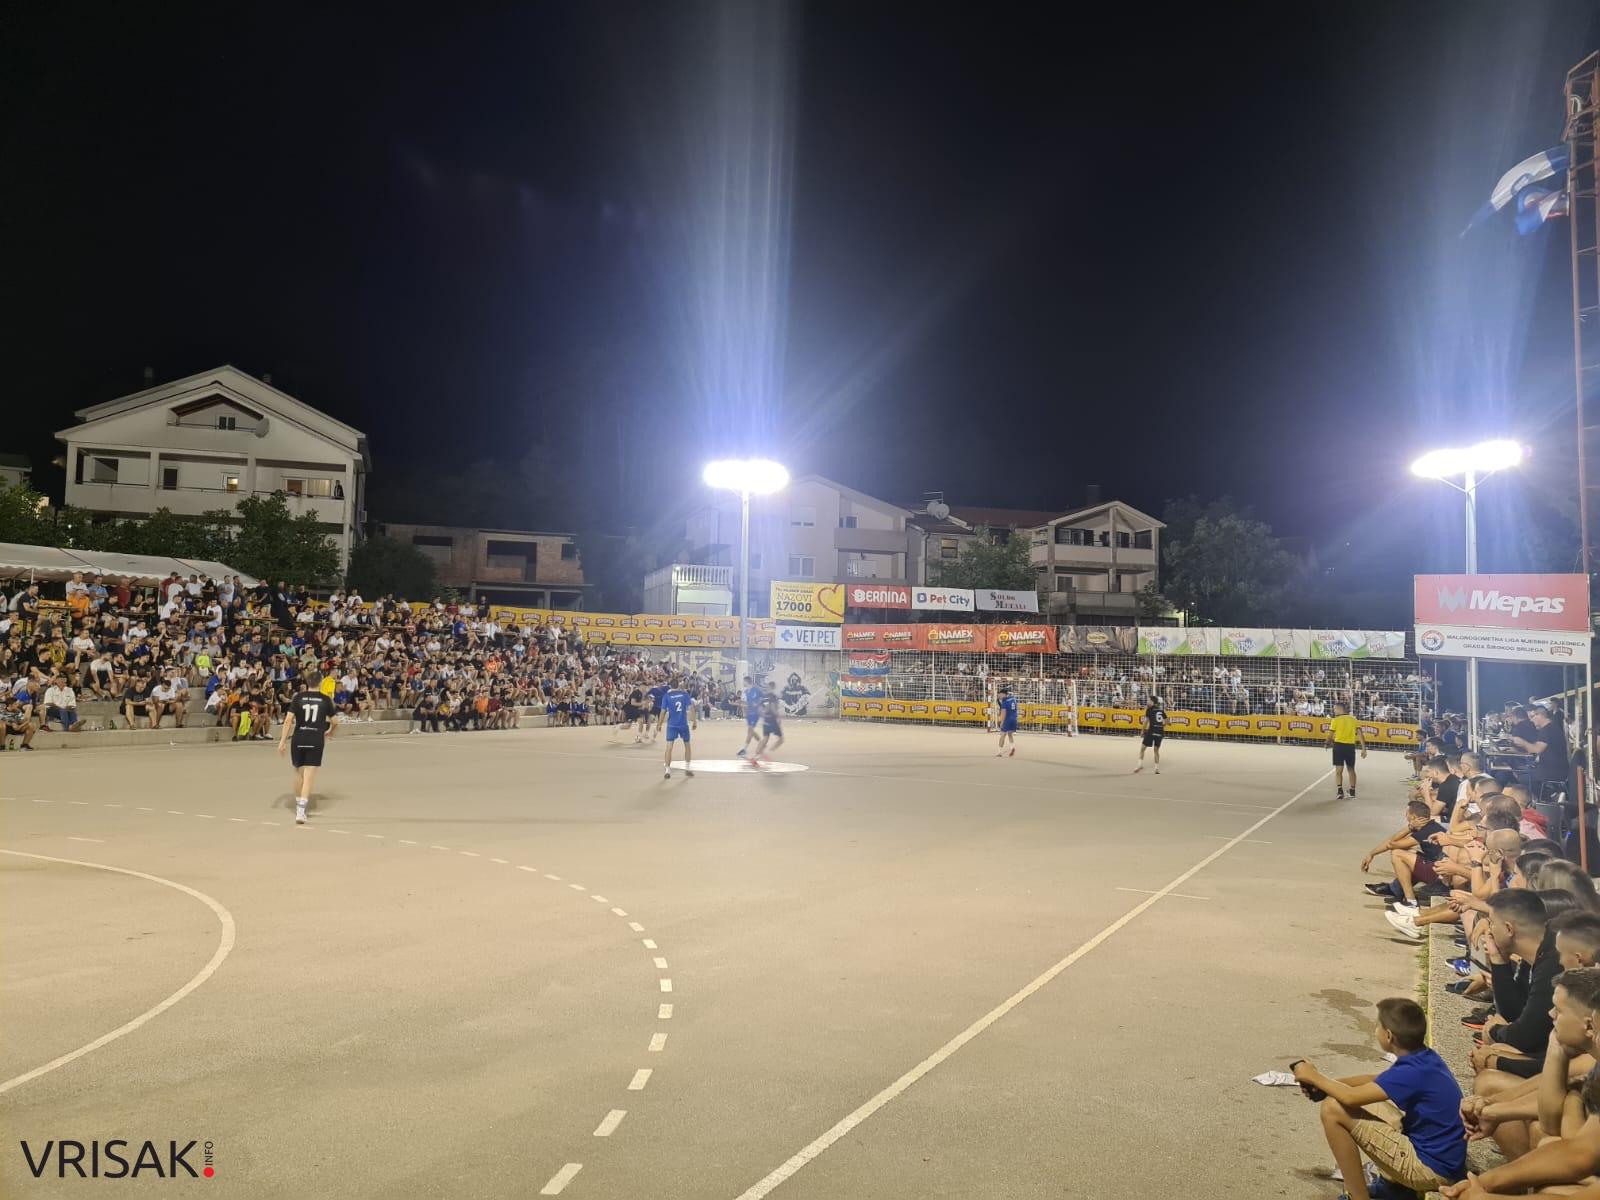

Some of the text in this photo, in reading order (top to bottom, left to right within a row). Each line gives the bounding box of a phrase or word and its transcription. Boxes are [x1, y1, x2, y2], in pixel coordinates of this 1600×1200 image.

[853, 588, 908, 604] BERNINA
[930, 593, 970, 607] Pet City
[776, 600, 812, 612] 17000
[1469, 589, 1566, 618] Mepas
[796, 629, 836, 644] VET PET
[939, 629, 974, 640] NAMEX
[1008, 630, 1046, 641] NAMEX
[302, 703, 319, 723] 11
[675, 701, 682, 712] 2
[1155, 711, 1163, 723] 6
